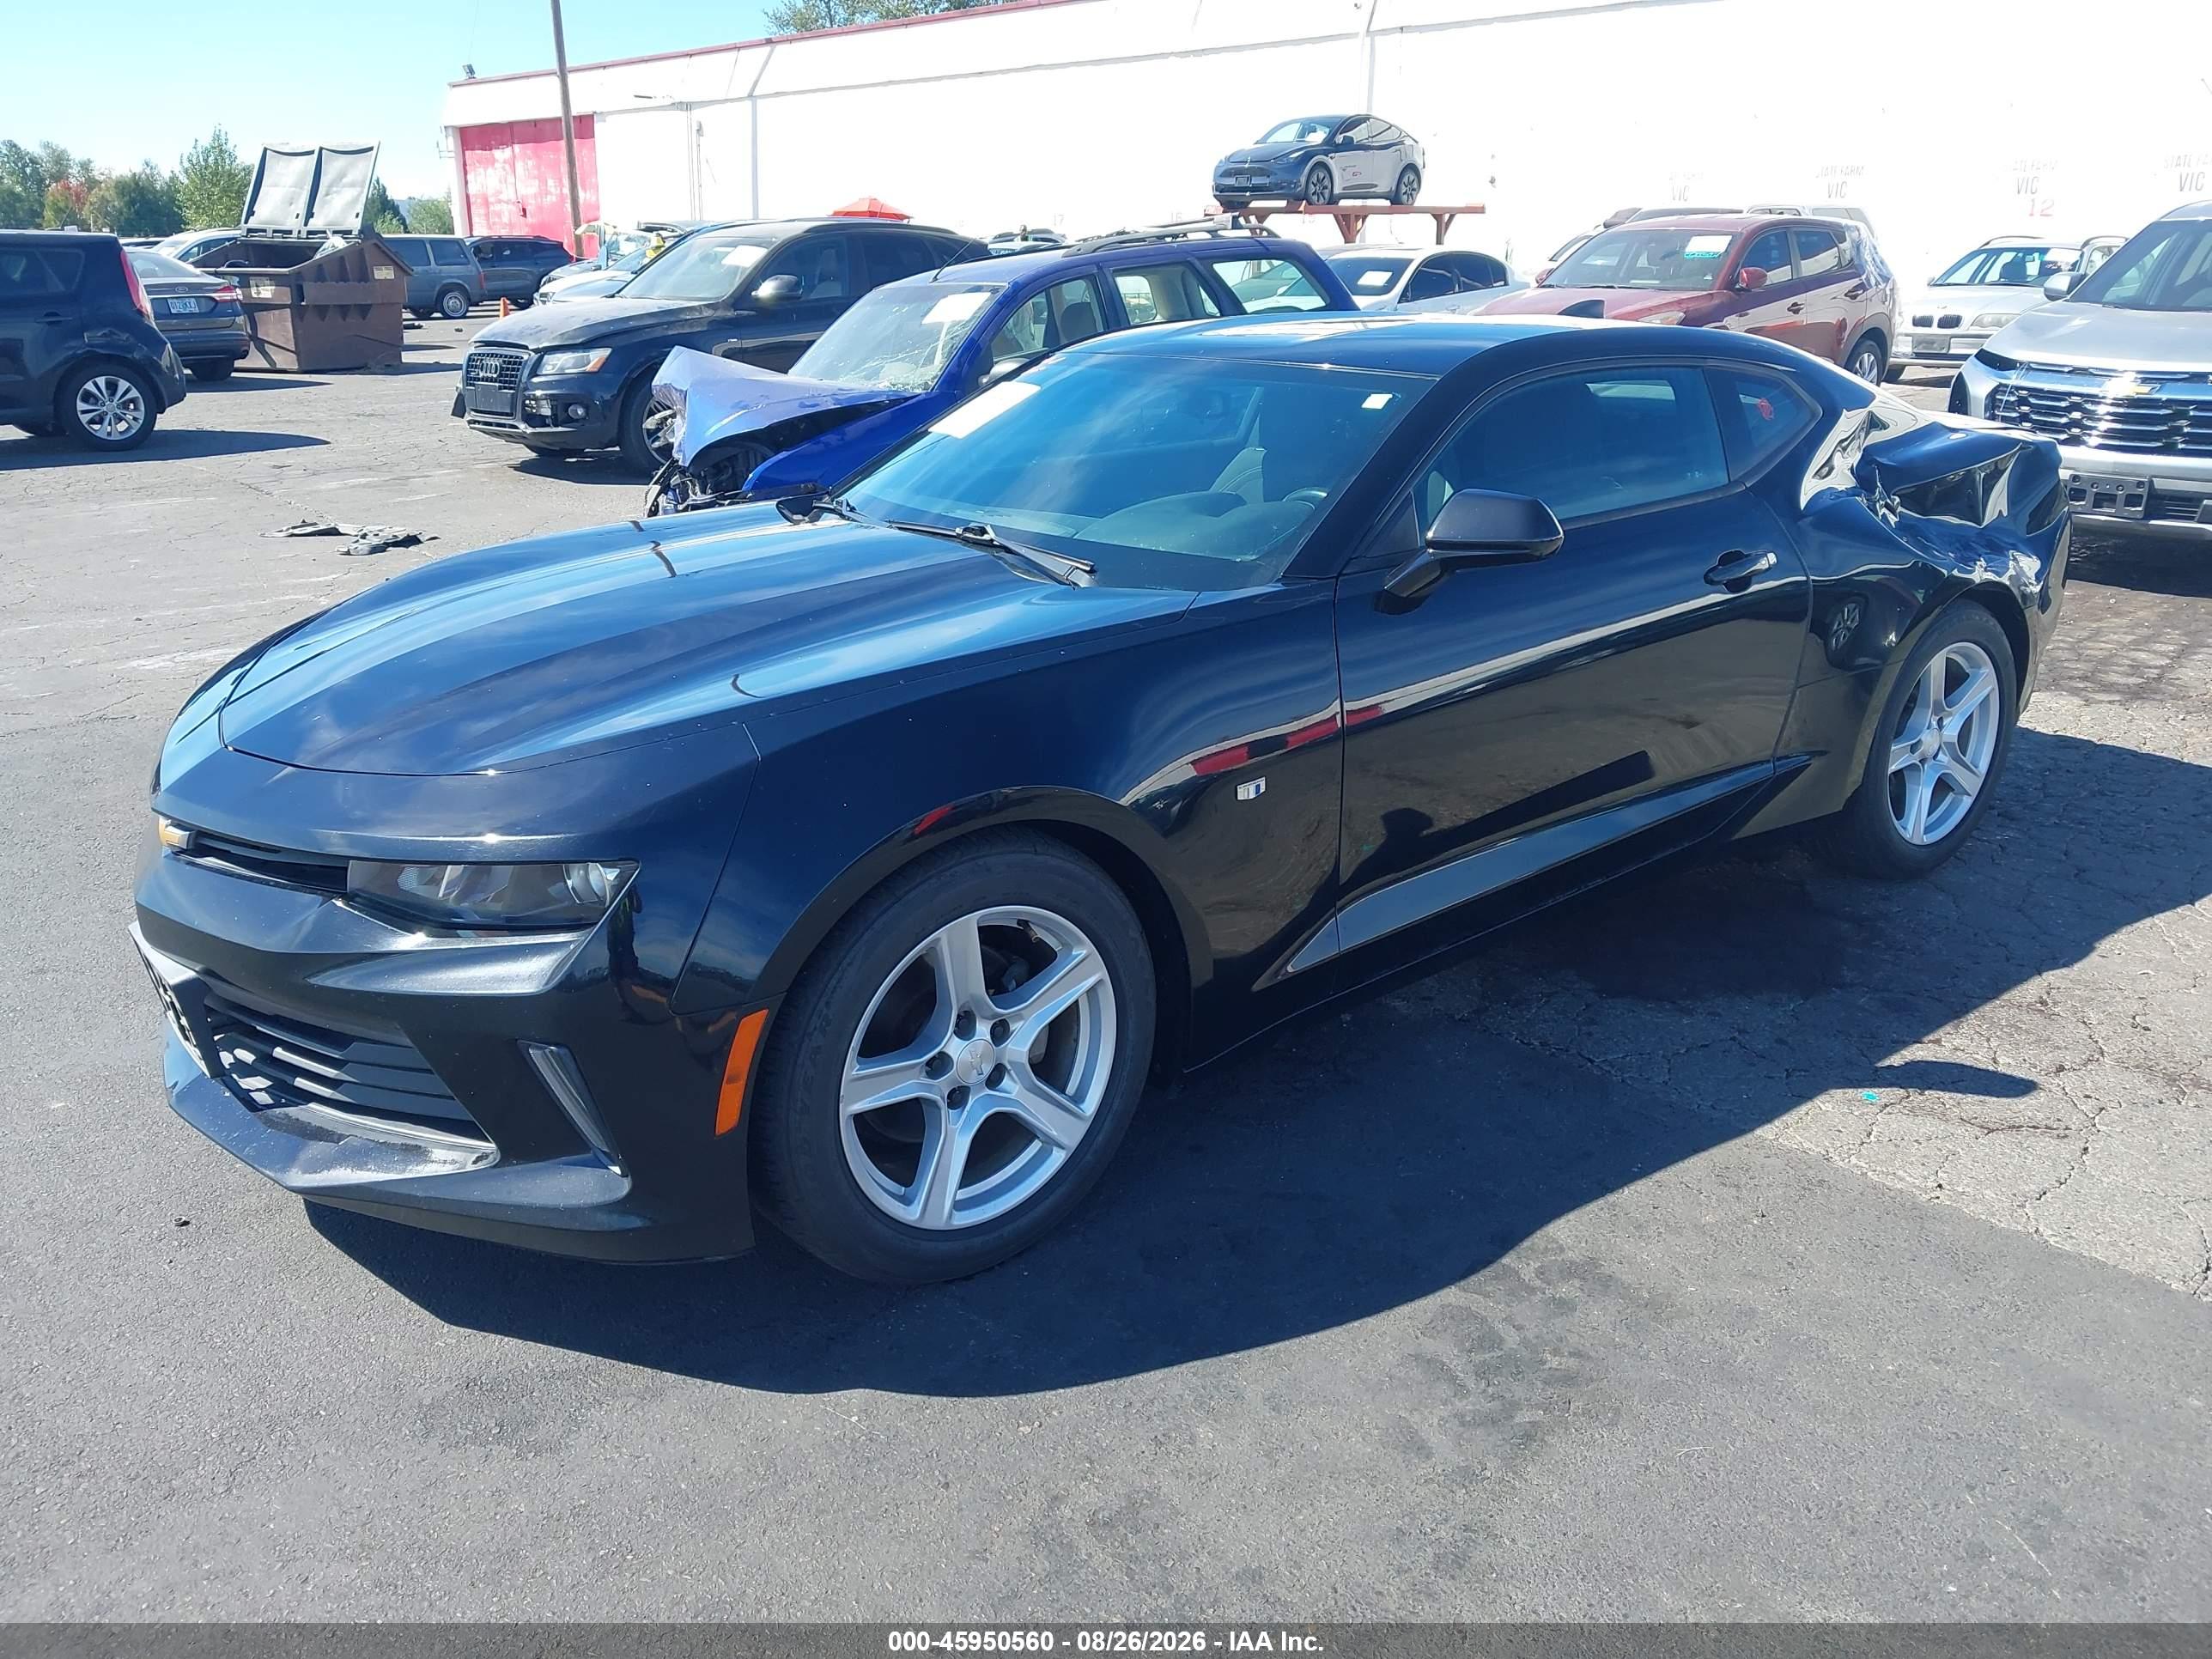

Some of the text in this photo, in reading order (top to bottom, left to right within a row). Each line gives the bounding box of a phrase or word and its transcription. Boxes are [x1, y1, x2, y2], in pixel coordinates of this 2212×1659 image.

[1827, 180, 1848, 199] VIC
[2016, 175, 2039, 195] VIC
[2179, 171, 2205, 192] VIC
[1672, 185, 1690, 202] VIC
[2029, 198, 2054, 217] 12
[1054, 213, 1065, 227] 17
